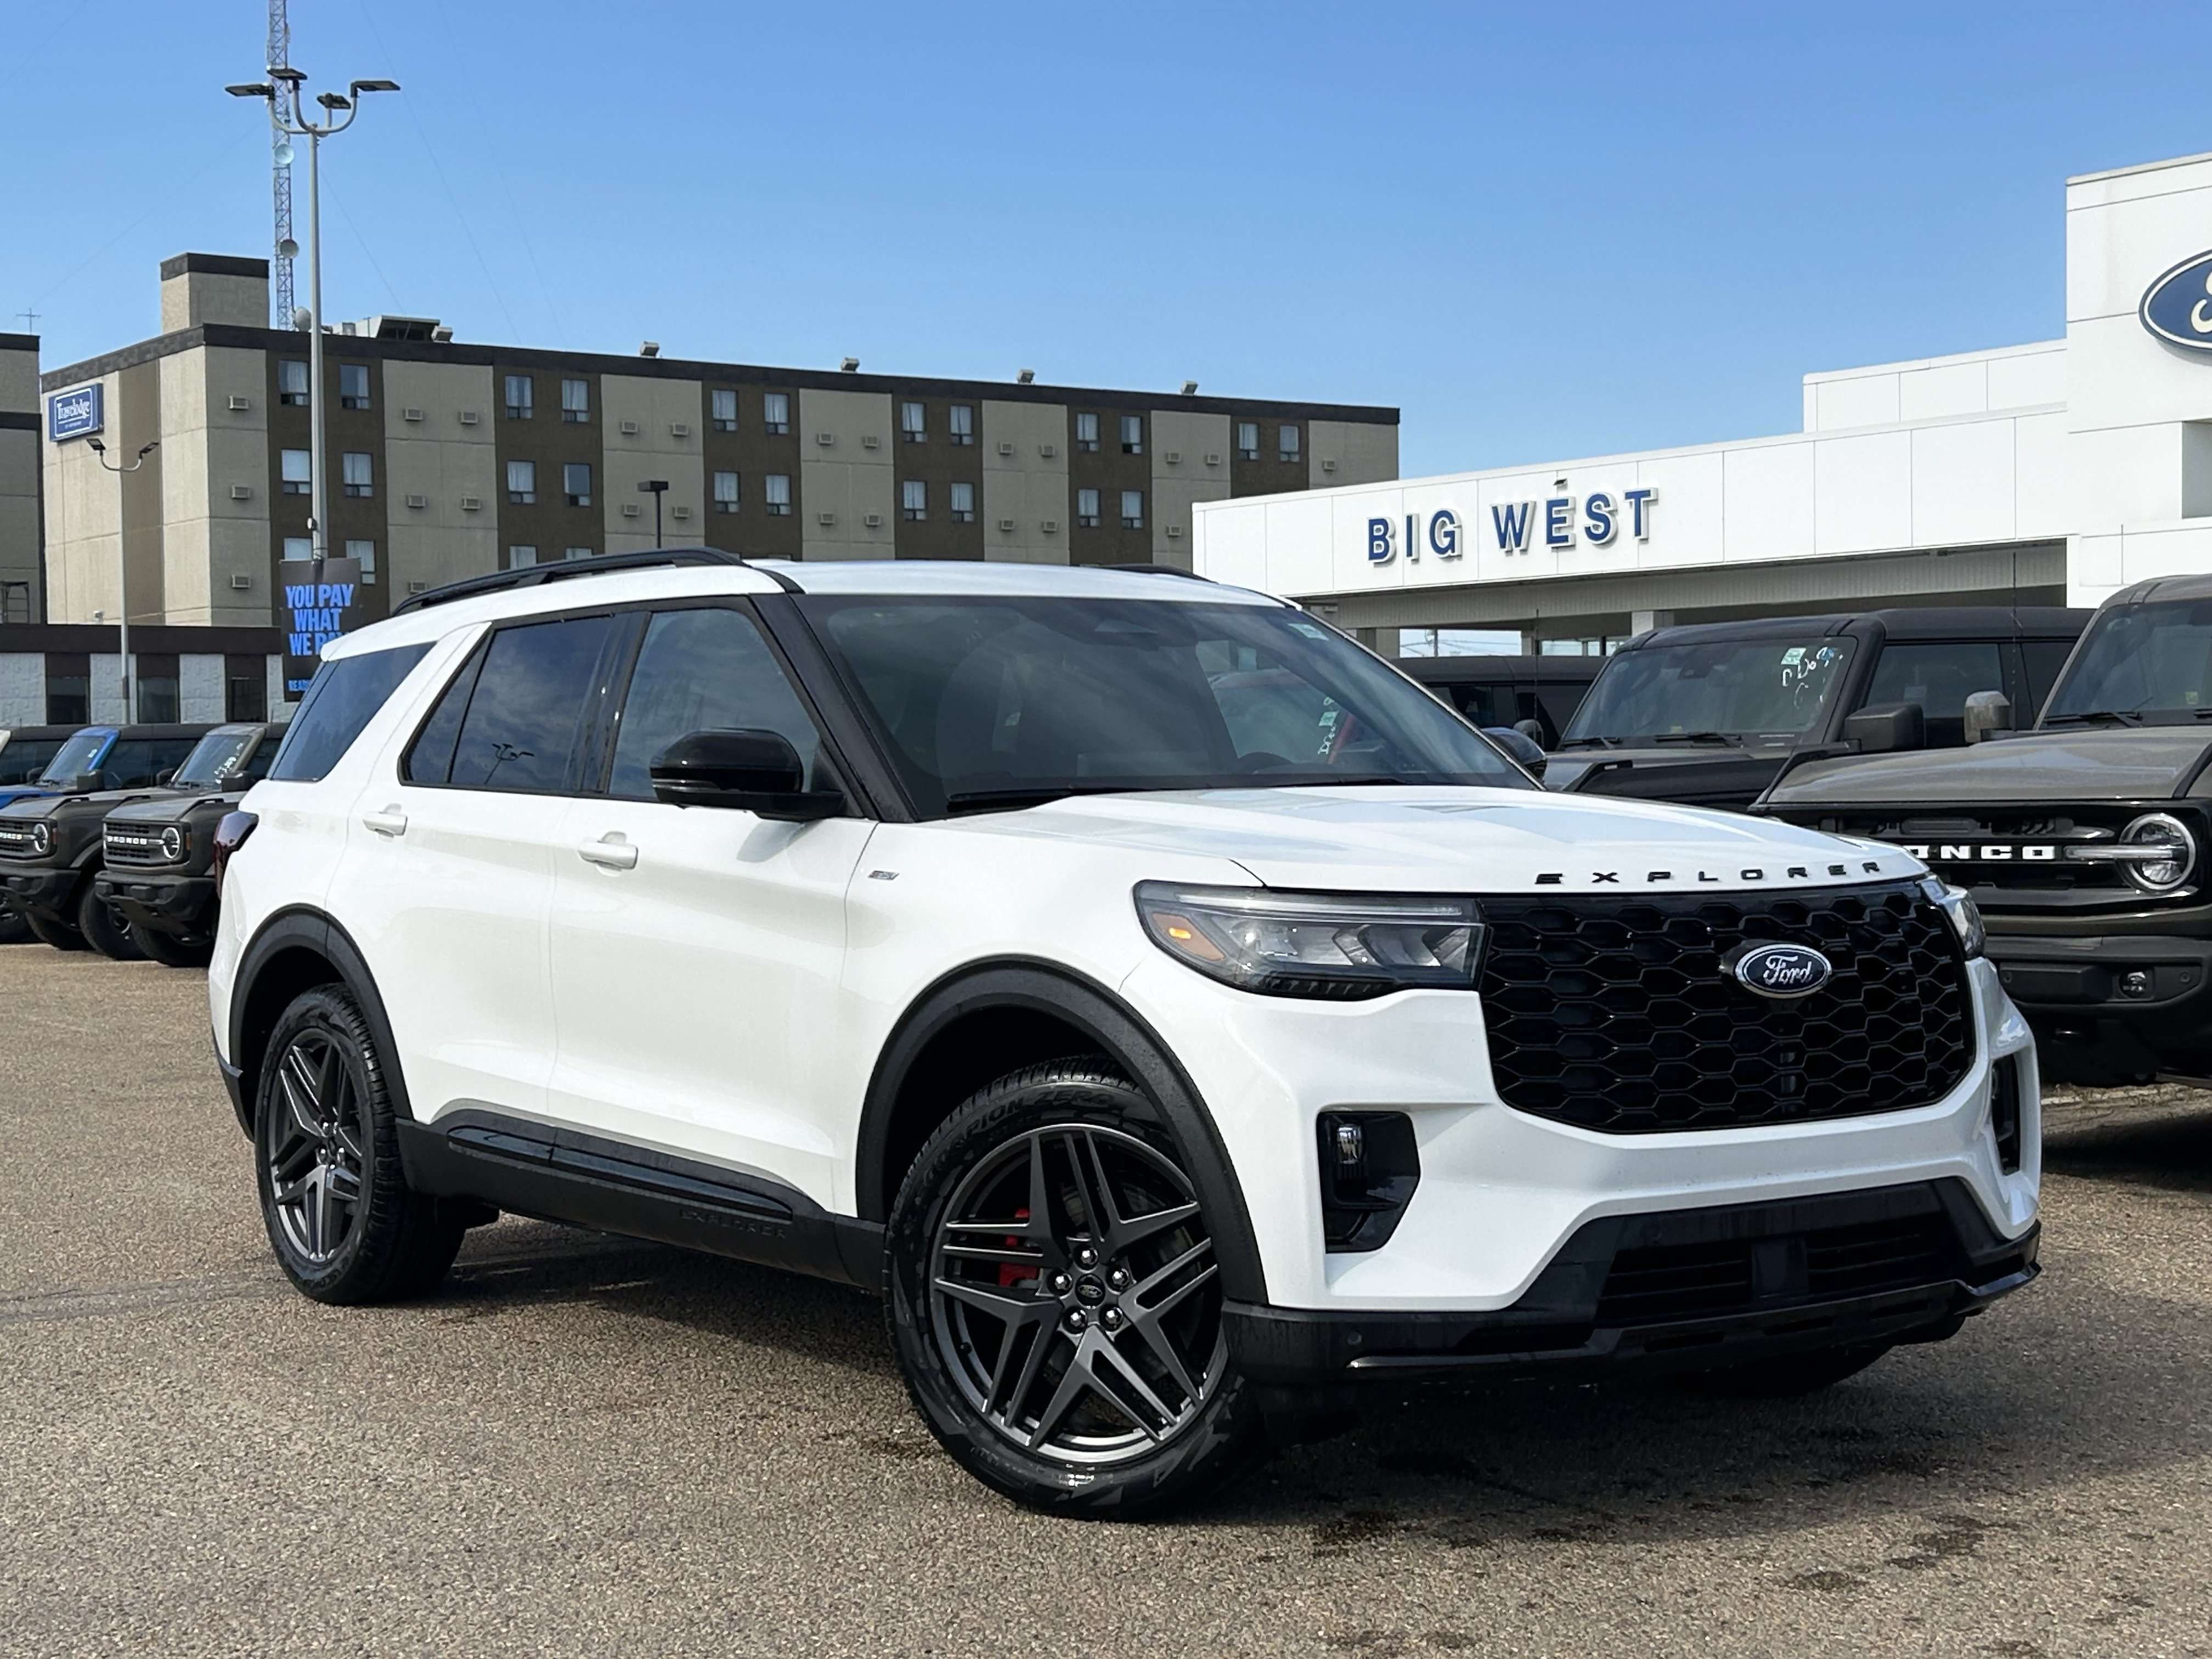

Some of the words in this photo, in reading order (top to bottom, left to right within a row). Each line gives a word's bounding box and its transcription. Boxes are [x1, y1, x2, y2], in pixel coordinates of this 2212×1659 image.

[1367, 508, 1464, 565] BIG
[1491, 488, 1658, 554] WEST
[285, 585, 315, 608] YOU
[318, 583, 354, 607] PAY
[294, 608, 342, 631] WHAT
[289, 633, 312, 656] WE
[1536, 861, 1880, 884] EXPLORER
[1763, 955, 1813, 985] Ford
